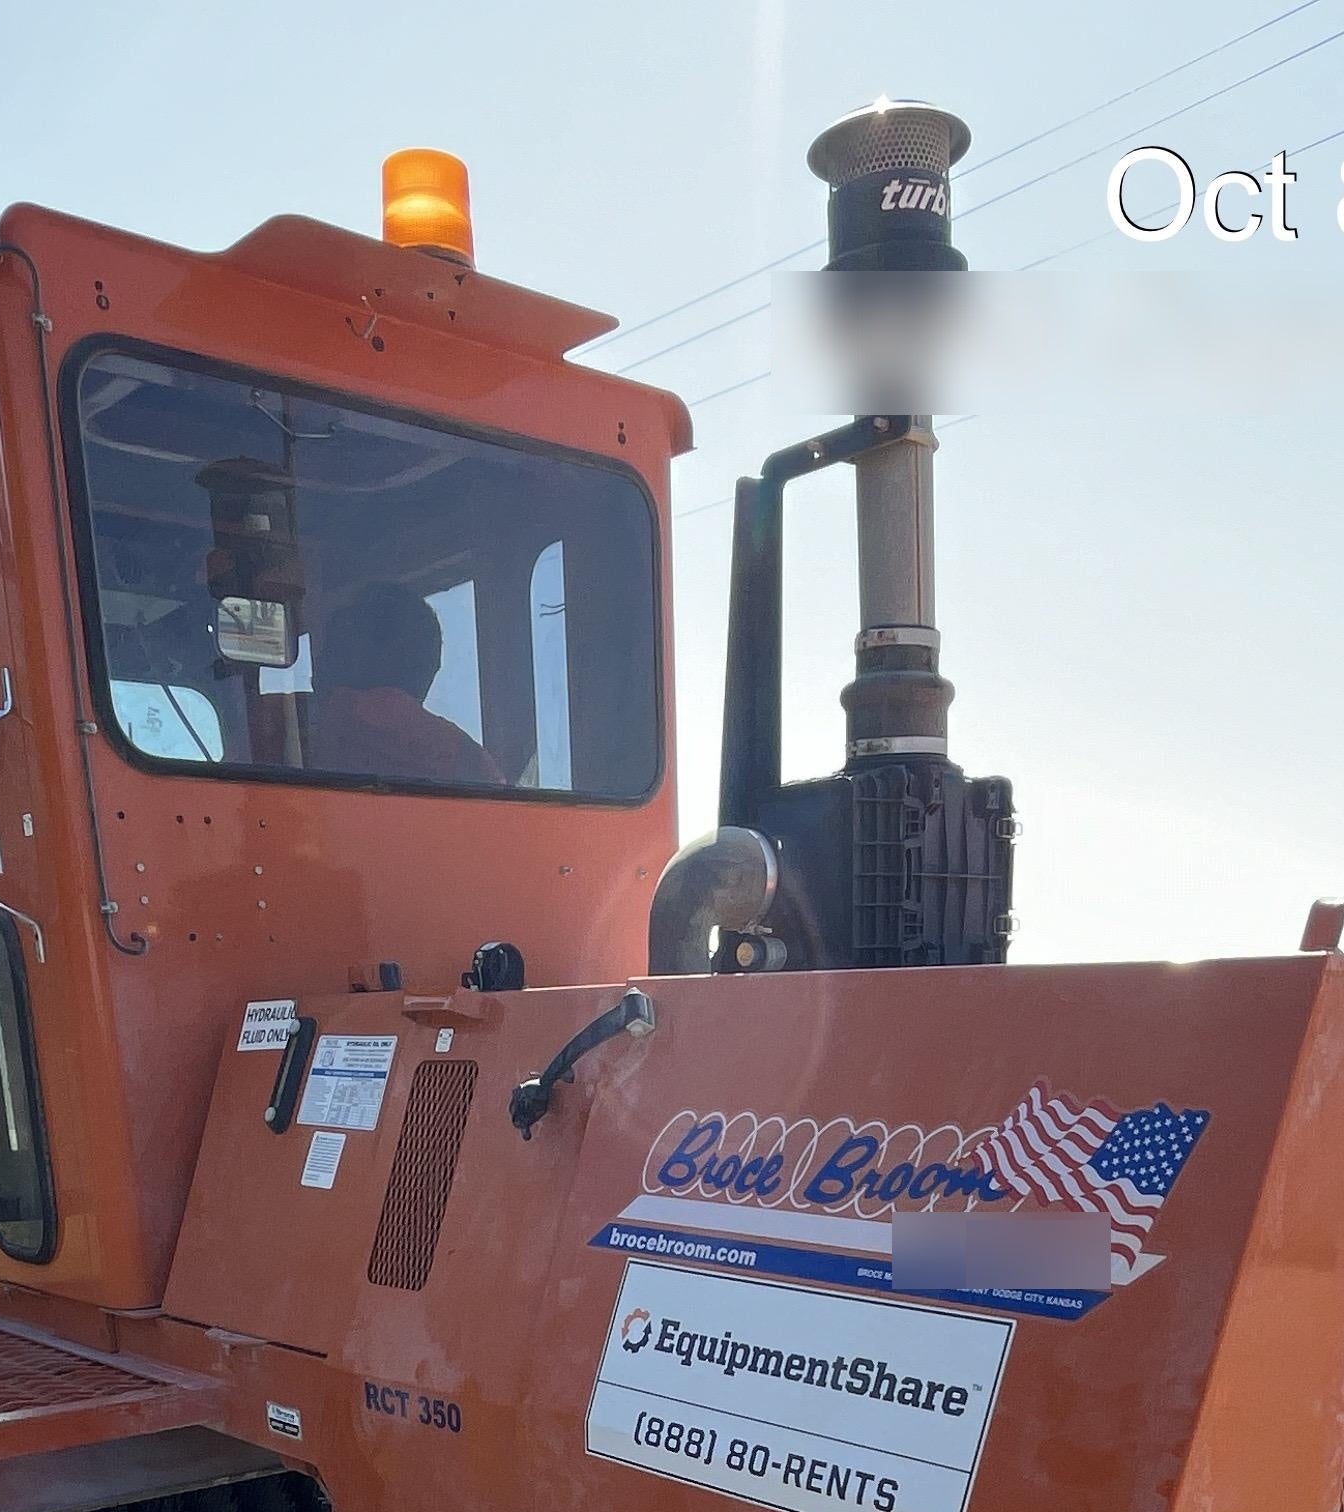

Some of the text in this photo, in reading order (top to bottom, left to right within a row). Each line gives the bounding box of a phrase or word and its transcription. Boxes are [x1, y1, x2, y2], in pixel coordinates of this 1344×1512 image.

[241, 1029, 266, 1046] FLUID
[657, 1119, 1011, 1204] Broce Broom
[608, 1227, 757, 1267] brocebroom.com
[992, 1288, 1022, 1301] DODGE
[1046, 1295, 1083, 1309] KANSAS
[654, 1318, 970, 1417] EquipmentShare
[364, 1381, 462, 1434] RCT 350
[633, 1410, 899, 1512] (888) 80-RENTS
